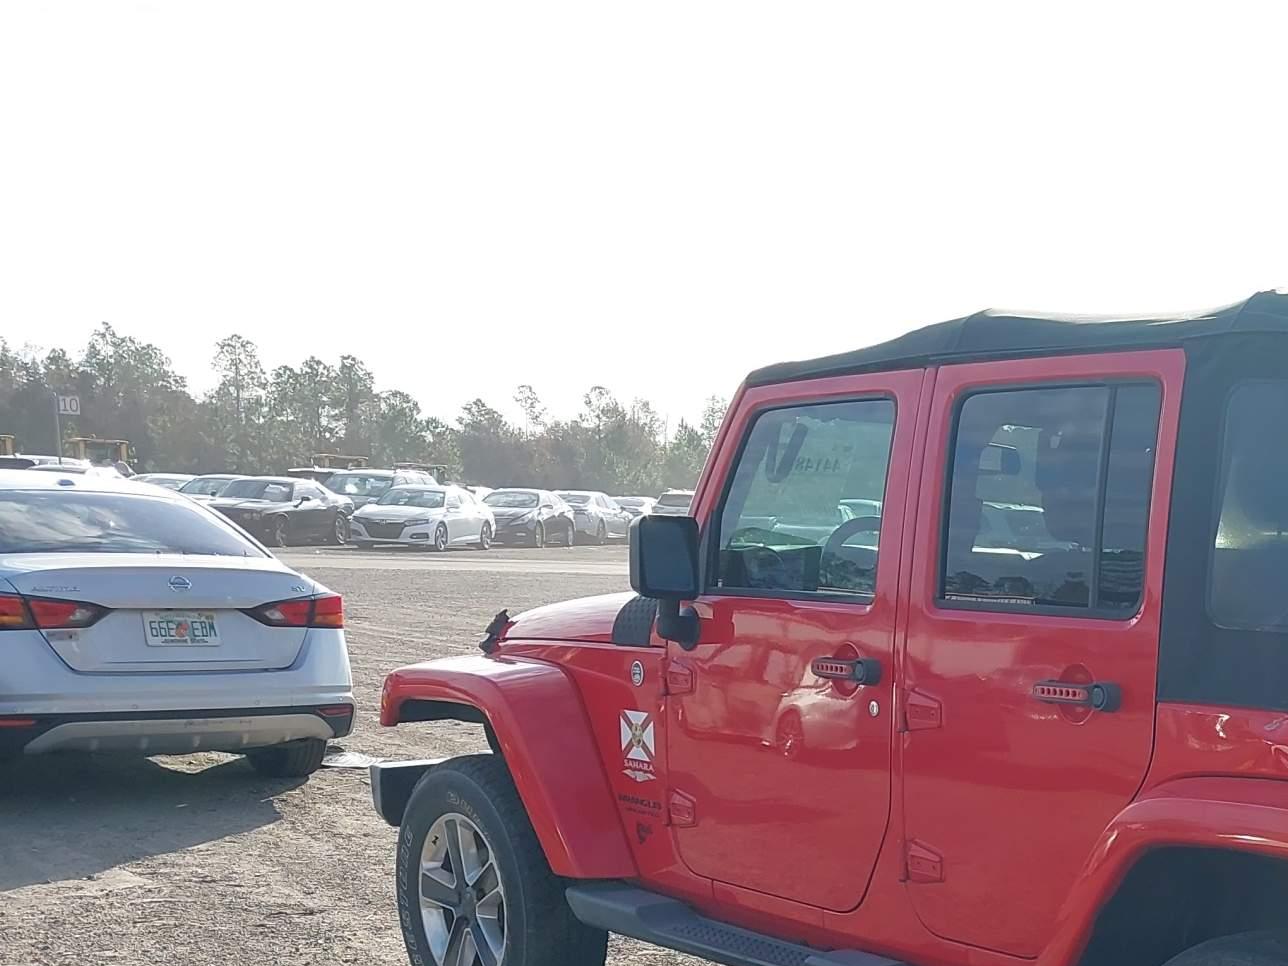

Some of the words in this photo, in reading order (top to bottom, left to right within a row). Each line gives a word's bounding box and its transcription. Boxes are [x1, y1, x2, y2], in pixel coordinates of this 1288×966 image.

[62, 398, 78, 412] 10
[149, 620, 176, 638] 66E
[624, 759, 656, 773] SAHARA
